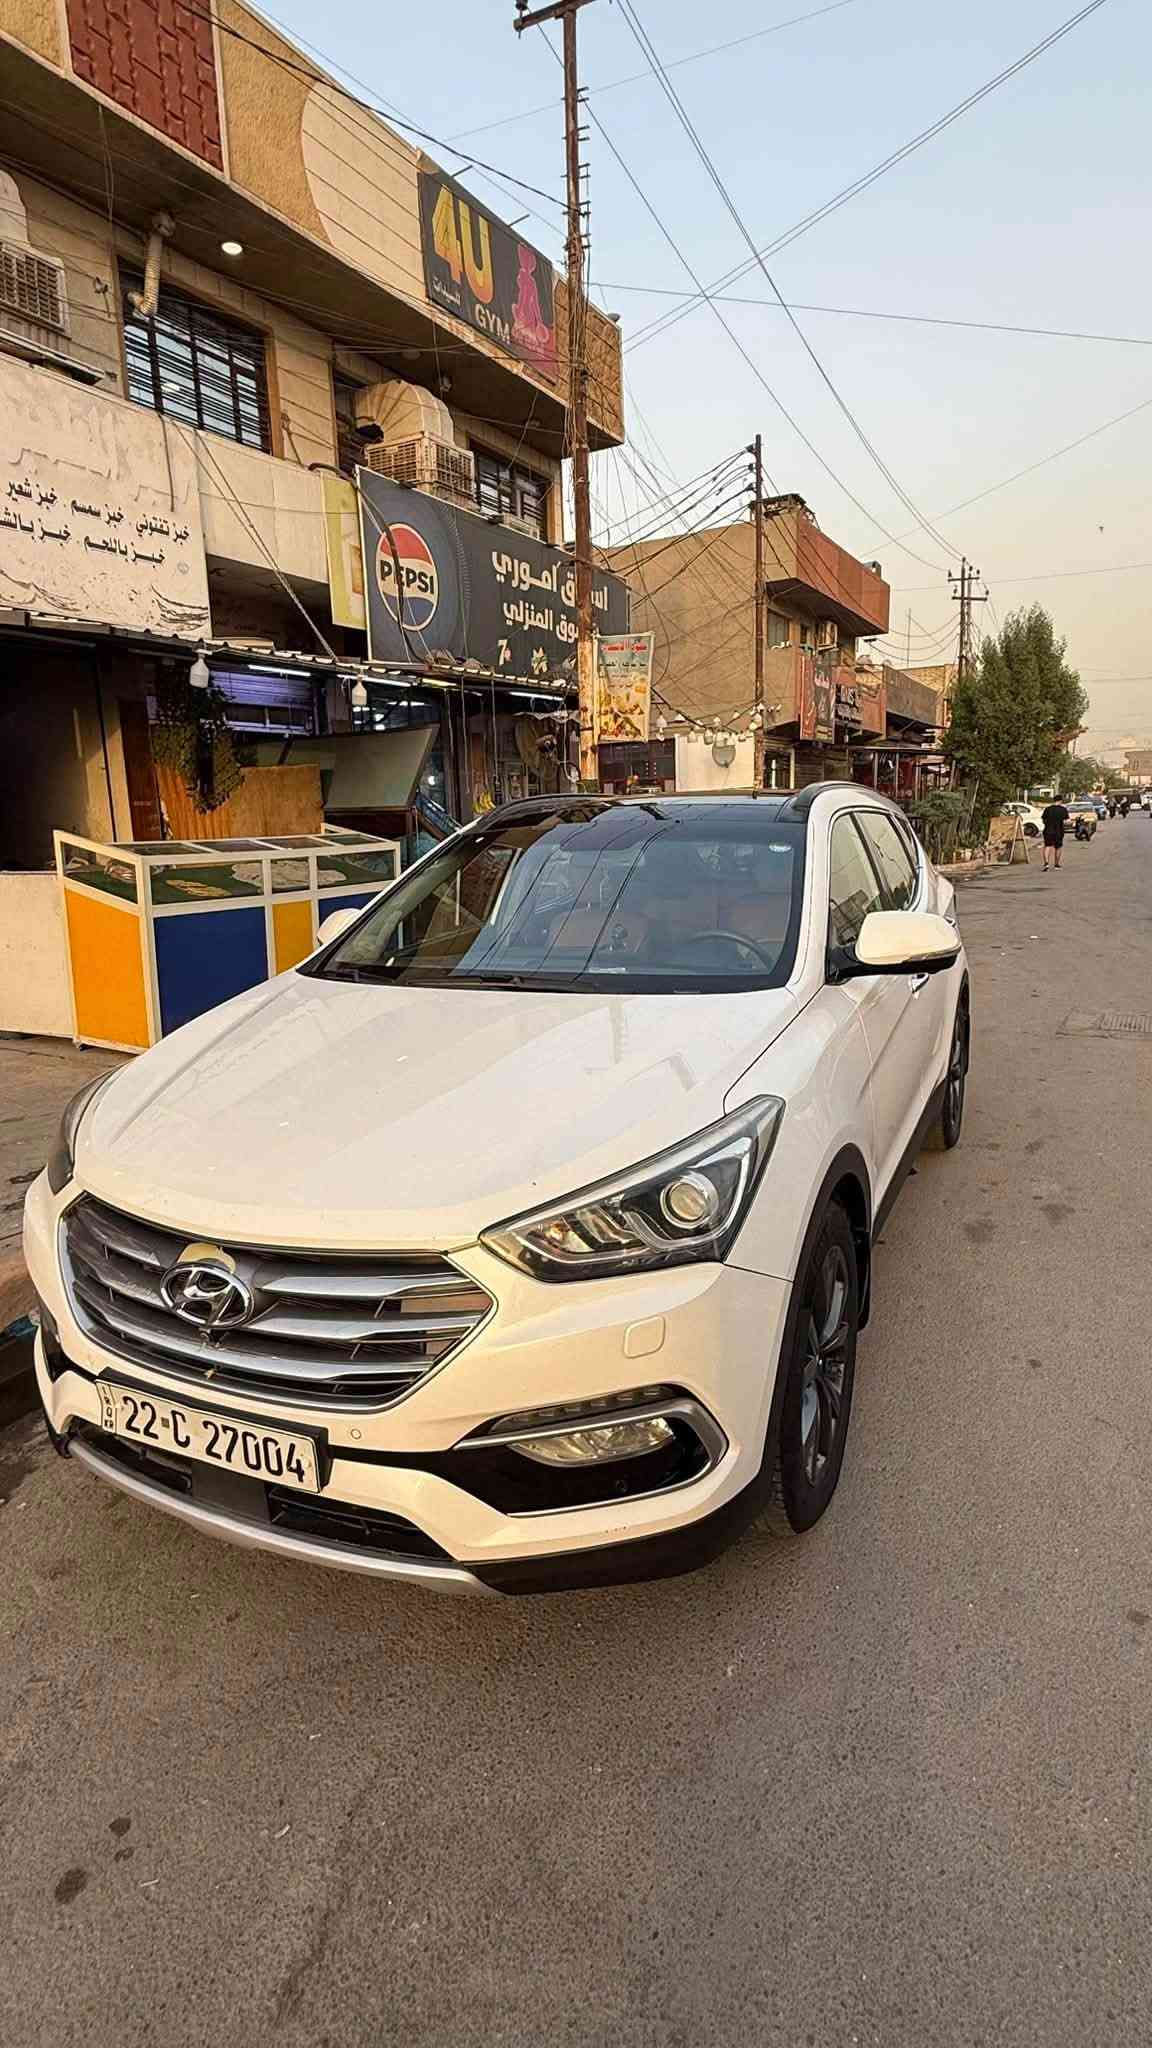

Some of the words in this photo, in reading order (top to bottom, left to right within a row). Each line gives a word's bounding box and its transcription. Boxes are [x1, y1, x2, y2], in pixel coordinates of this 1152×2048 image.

[432, 184, 493, 304] 4U
[475, 303, 510, 345] GYM
[6, 478, 33, 502] شعير
[36, 483, 58, 511] خبز
[105, 503, 124, 528] خبز
[39, 518, 71, 547] خبز
[173, 522, 190, 546] خبز
[84, 535, 128, 562] باللحم
[132, 541, 166, 569] خبز
[380, 559, 434, 595] PEPSI
[202, 1420, 305, 1483] 27004
